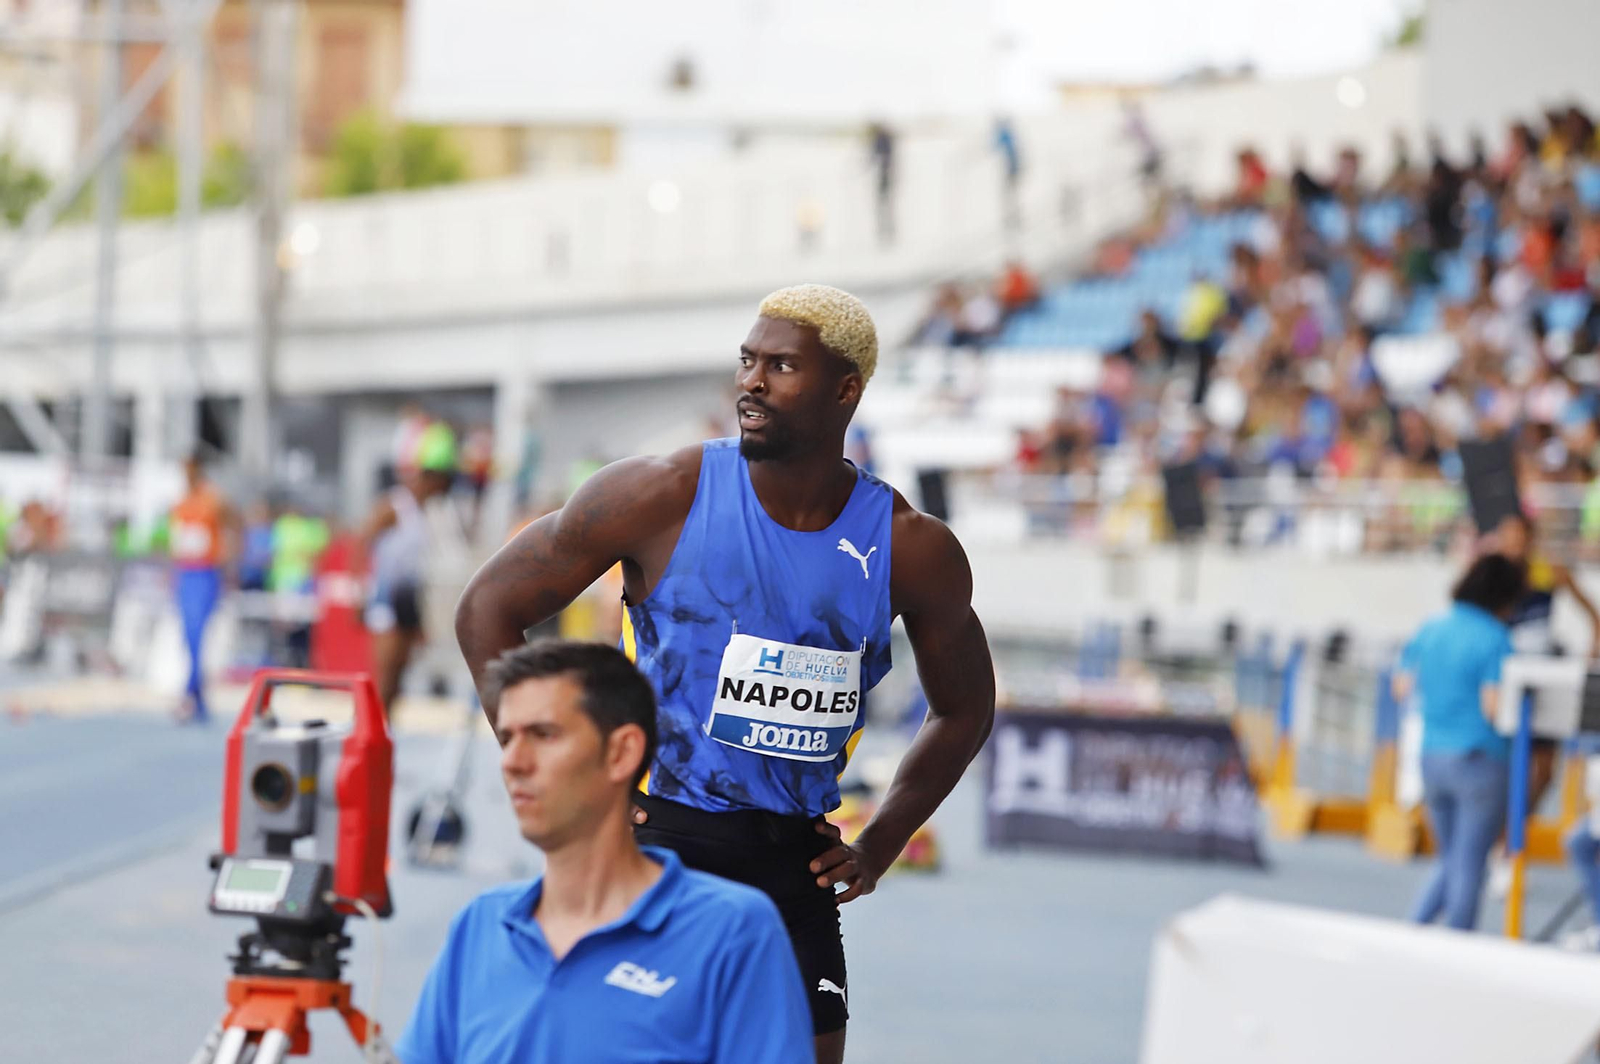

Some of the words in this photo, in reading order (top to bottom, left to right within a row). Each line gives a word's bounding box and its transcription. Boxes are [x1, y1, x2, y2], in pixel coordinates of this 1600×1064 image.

[786, 660, 801, 671] DE
[805, 663, 847, 676] HUELVA
[720, 677, 857, 713] NAPOLES
